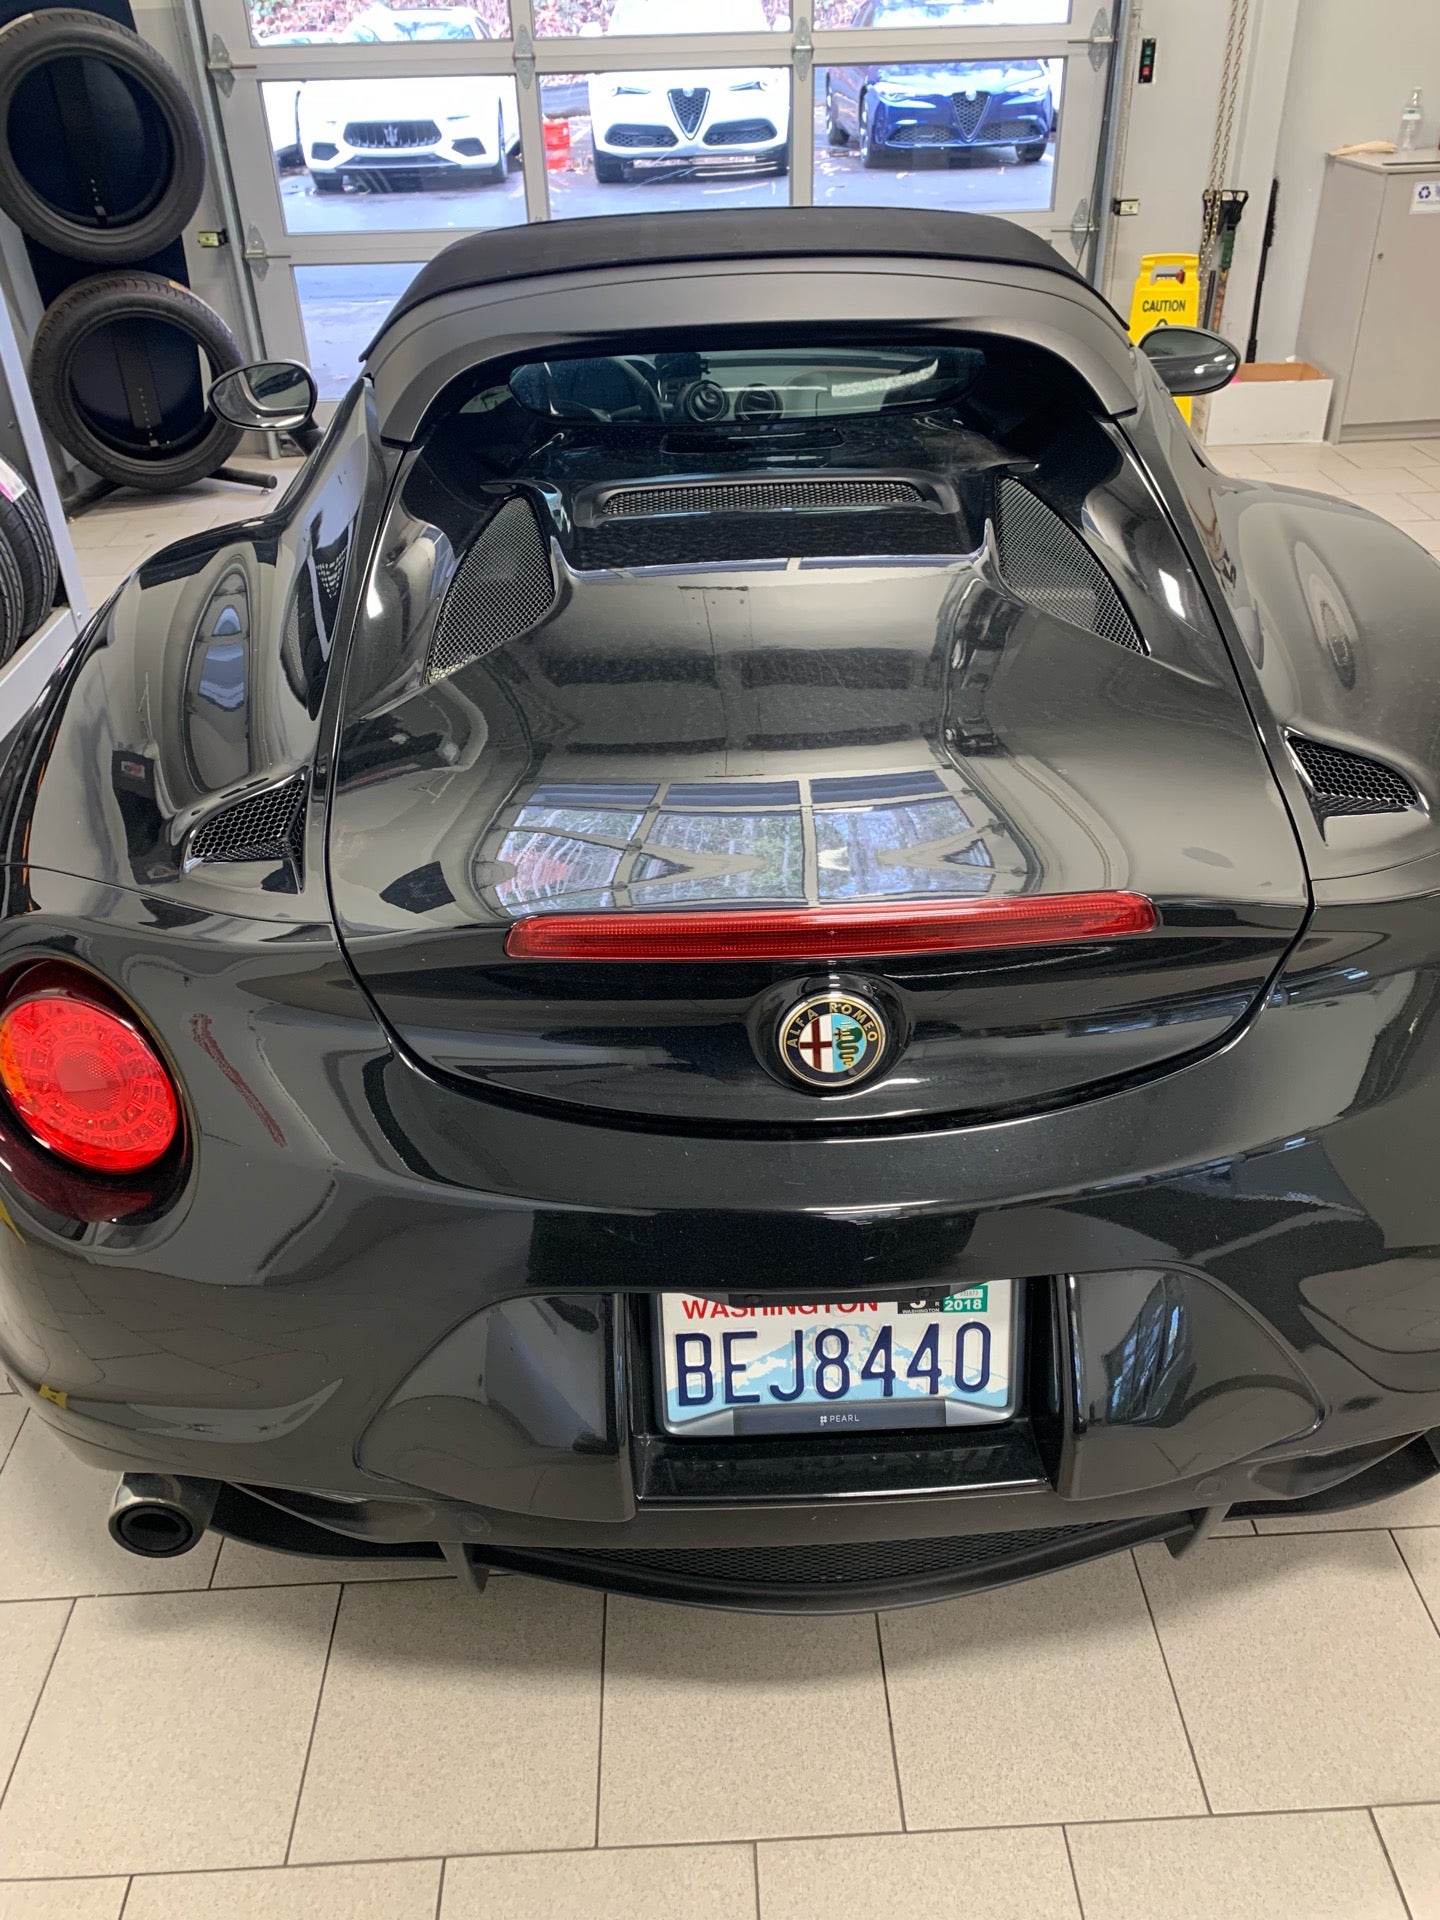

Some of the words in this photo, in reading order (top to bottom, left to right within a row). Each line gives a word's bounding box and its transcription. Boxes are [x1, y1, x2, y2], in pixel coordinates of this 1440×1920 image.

[1142, 300, 1186, 312] CAUTION
[787, 1008, 819, 1048] ALFA
[829, 1002, 878, 1042] ROMEO
[943, 1299, 983, 1311] 2018
[675, 1321, 991, 1406] BEJ8440
[829, 1414, 860, 1423] PEARL
